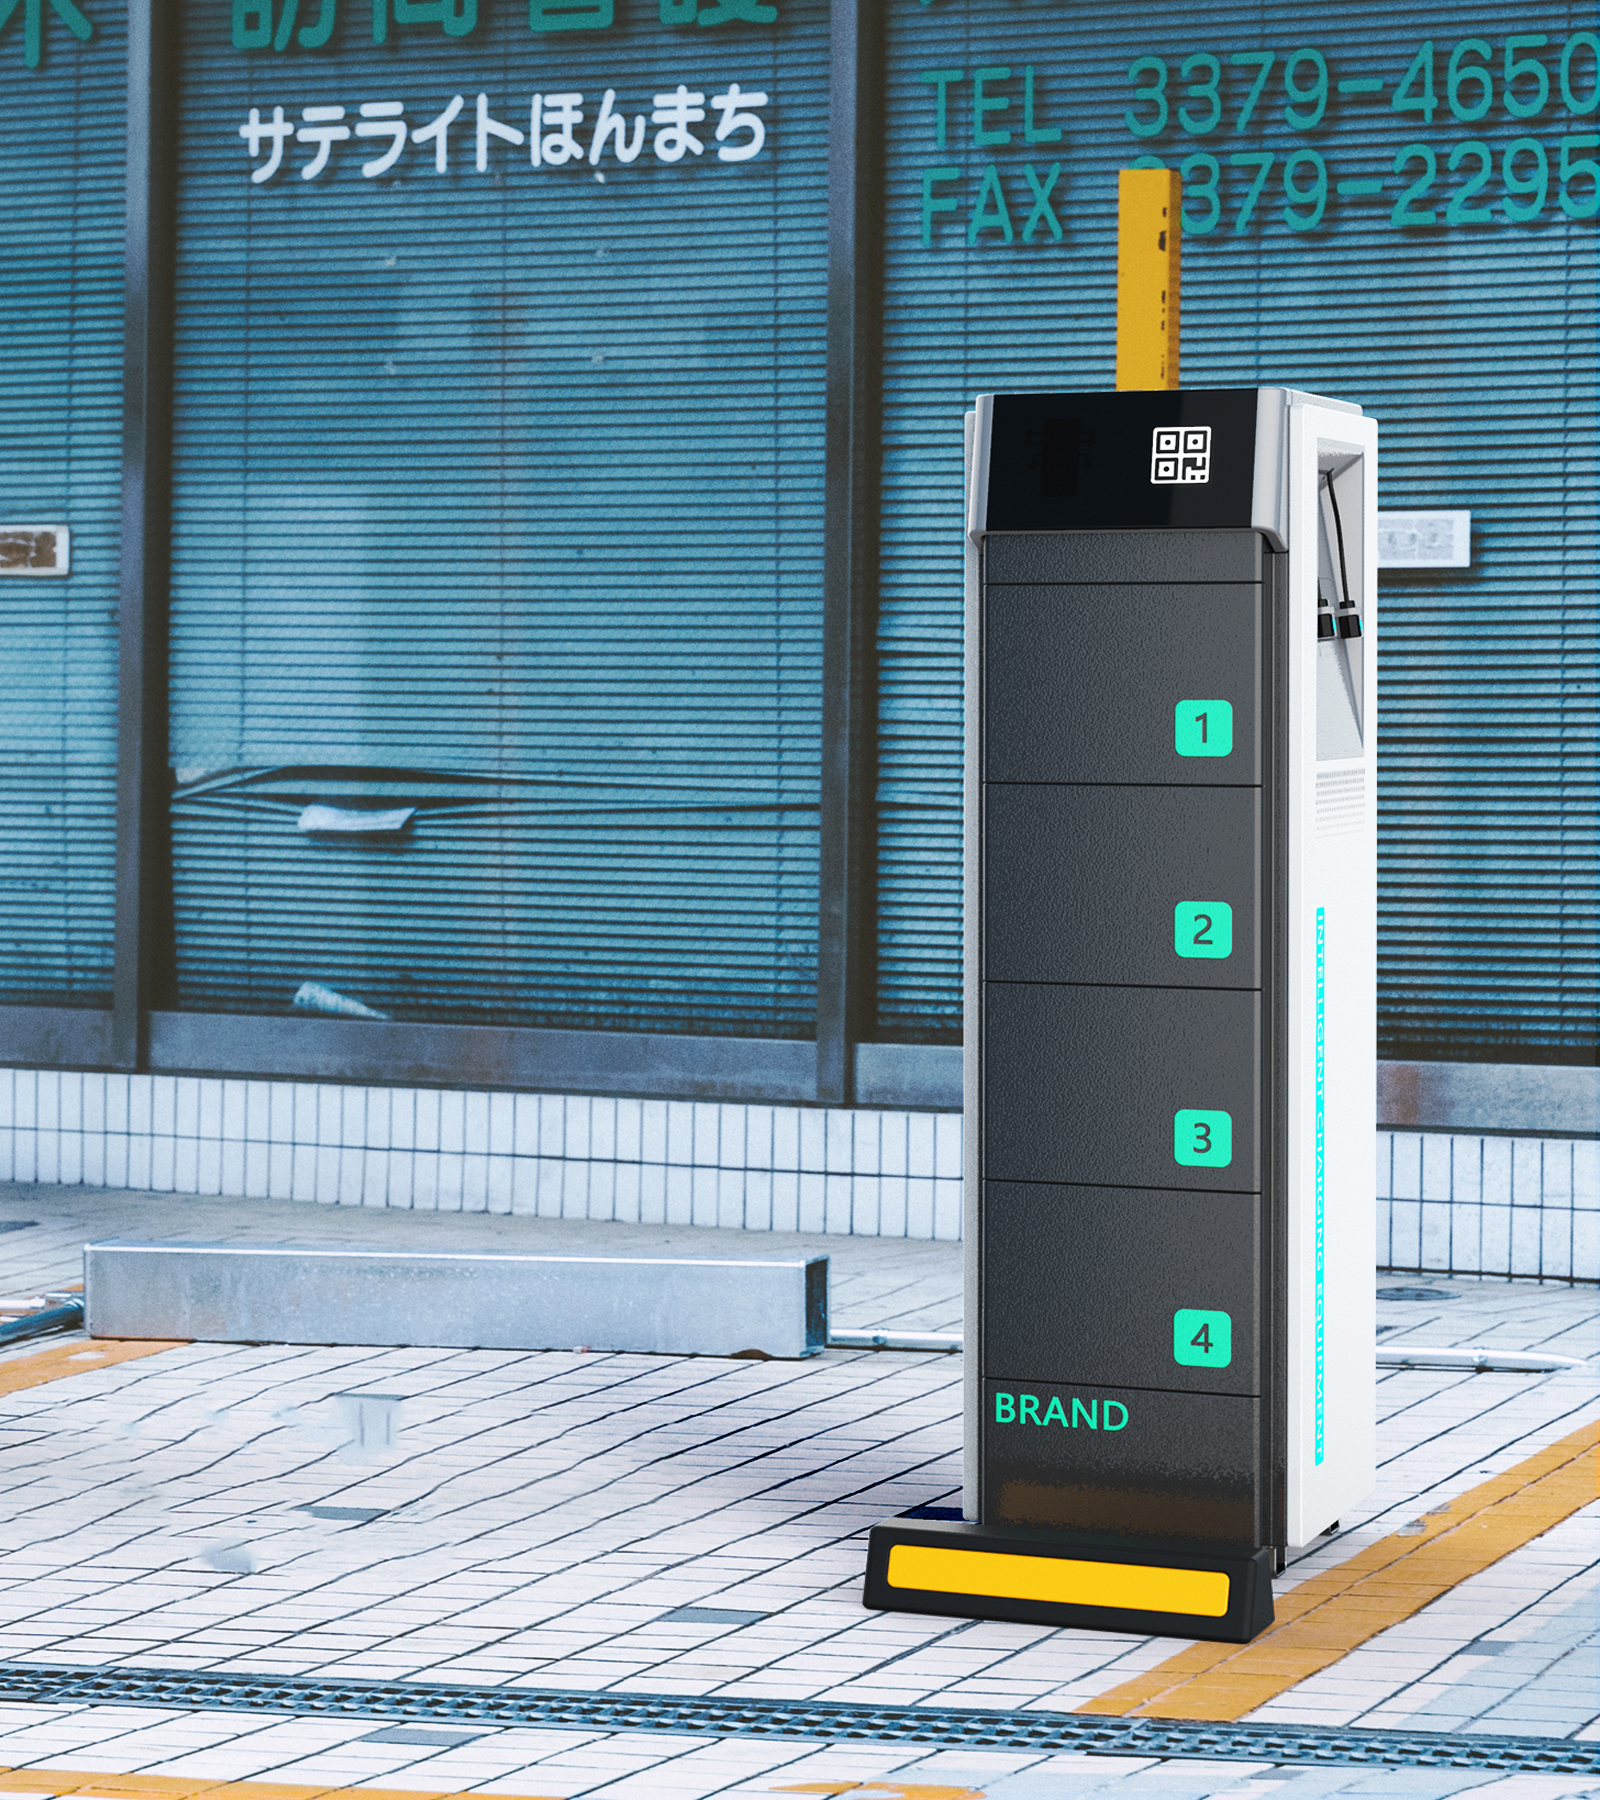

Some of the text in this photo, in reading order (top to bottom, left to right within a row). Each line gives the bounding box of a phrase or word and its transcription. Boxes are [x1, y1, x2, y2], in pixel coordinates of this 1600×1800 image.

[920, 31, 1600, 148] TEL 3379-4650
[238, 83, 770, 184] サテライトほんまち
[920, 132, 1600, 246] FAX 379-2295
[1195, 712, 1208, 744] 1
[1193, 914, 1213, 945] 2
[1193, 1122, 1212, 1154] 3
[1190, 1323, 1214, 1354] 4
[995, 1392, 1129, 1432] BRAND
